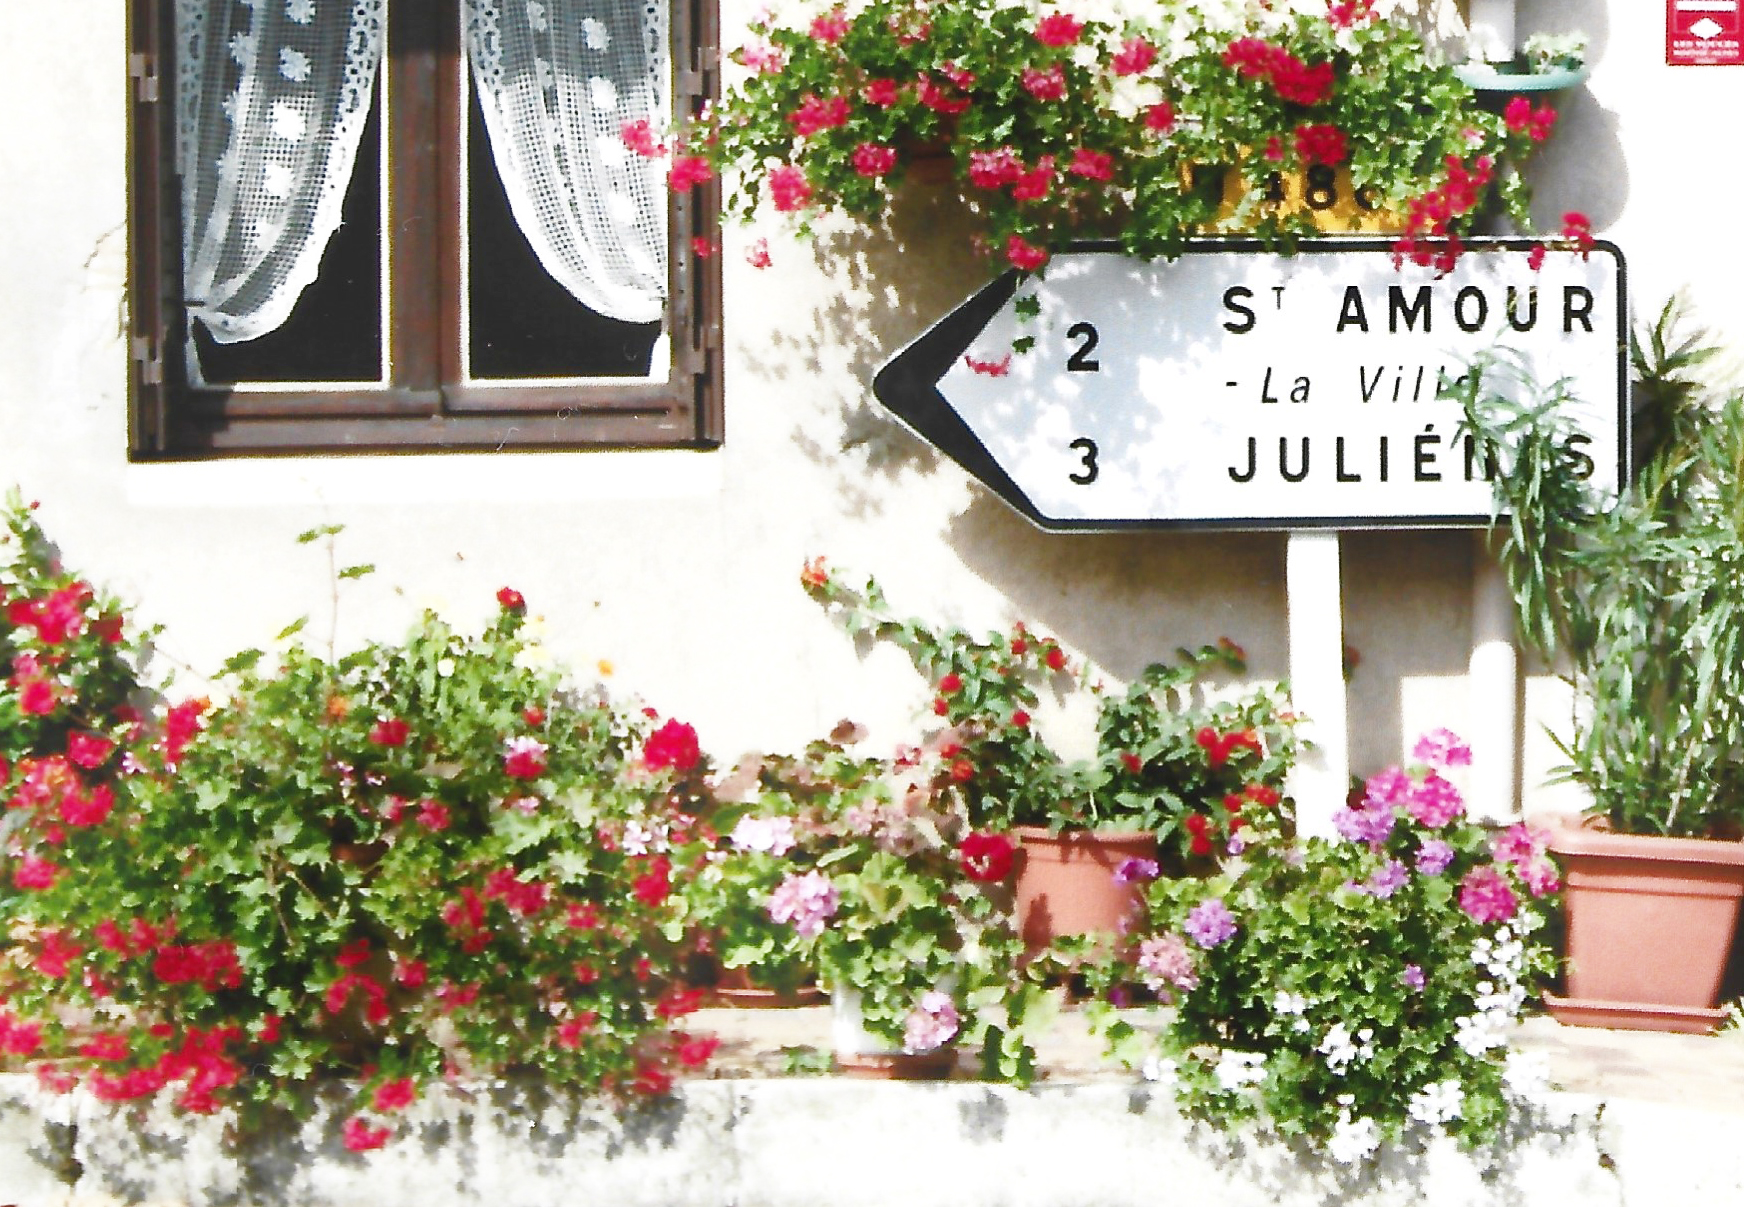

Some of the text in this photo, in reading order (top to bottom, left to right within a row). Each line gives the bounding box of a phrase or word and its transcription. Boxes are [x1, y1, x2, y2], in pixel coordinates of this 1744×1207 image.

[1336, 284, 1595, 335] AMOUR
[1066, 321, 1100, 372] 2
[1260, 365, 1312, 405] La
[1069, 436, 1100, 486] 3
[1227, 423, 1596, 484] JULIÉNS
